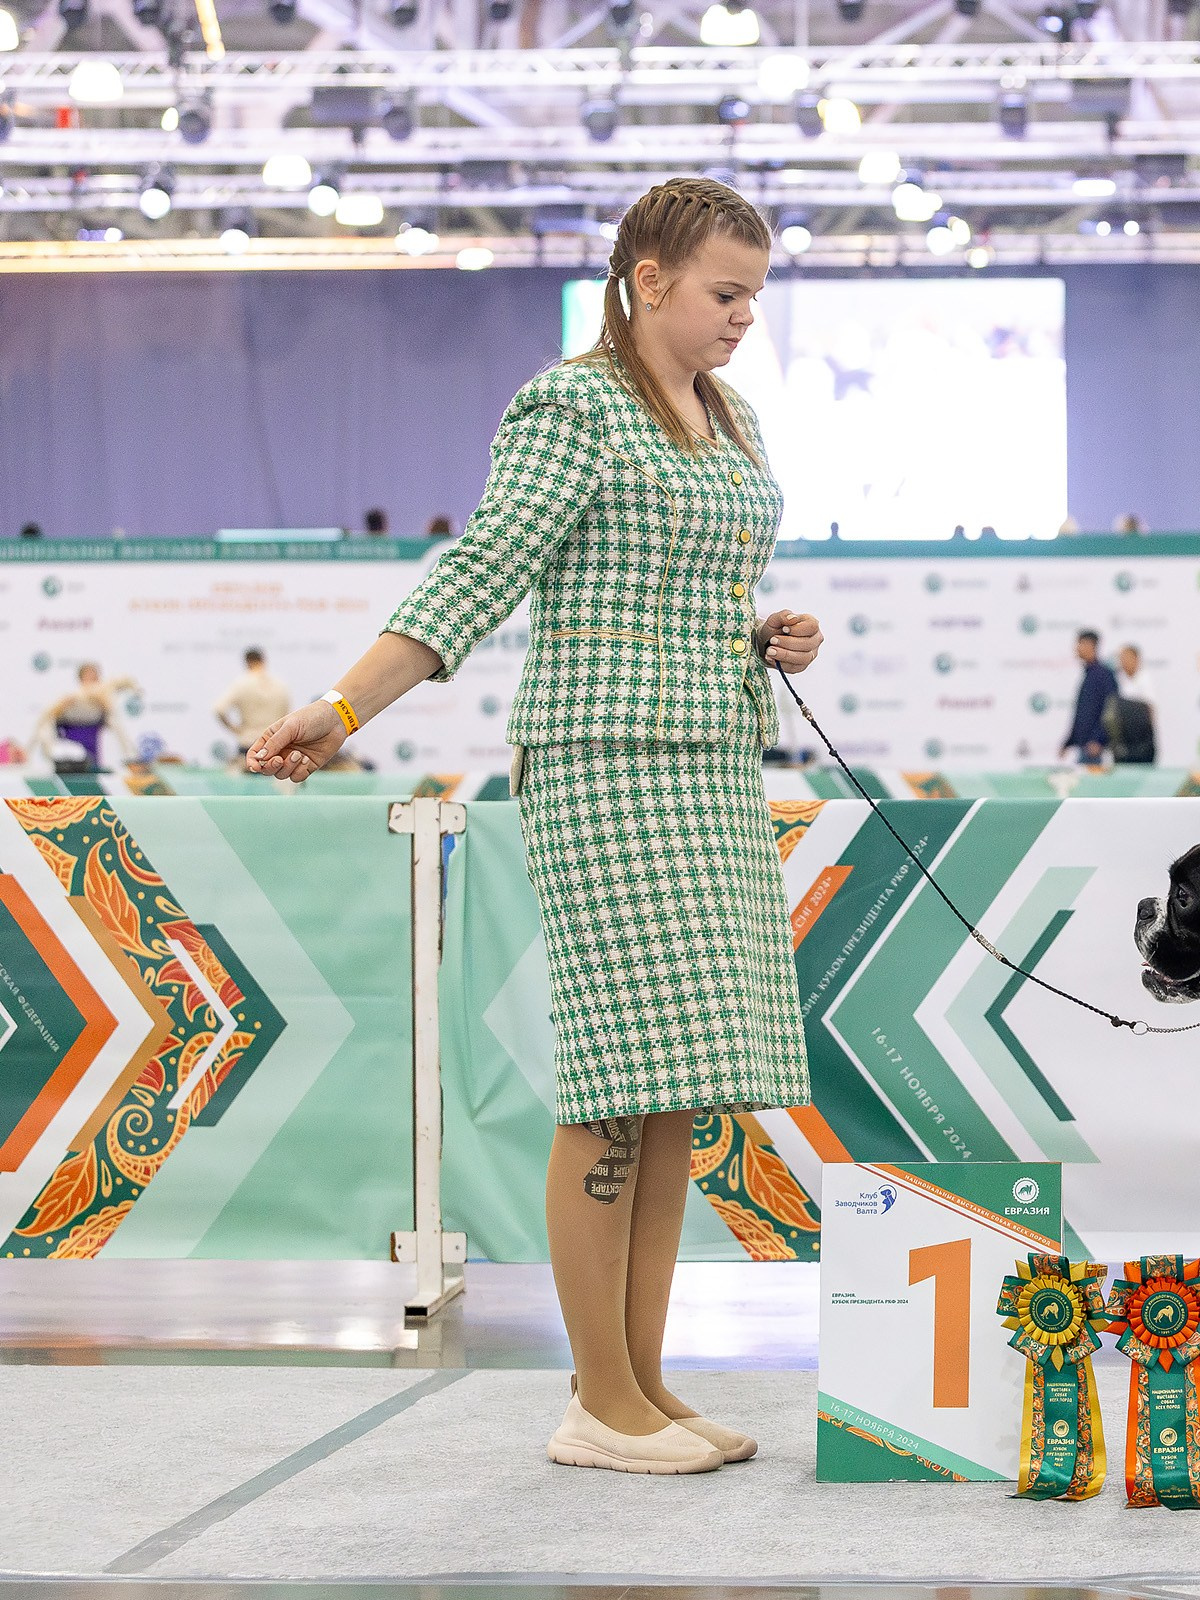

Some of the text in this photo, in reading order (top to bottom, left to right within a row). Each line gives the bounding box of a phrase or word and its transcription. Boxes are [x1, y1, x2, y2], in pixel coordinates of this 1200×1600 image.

[818, 955, 846, 992] КУБОК
[843, 887, 895, 956] ПРЕЗИДЕНТА
[890, 864, 910, 887] РКФ
[17, 995, 60, 1053] ФЕДЕРАЦИЯ
[900, 1066, 946, 1125] НОЯБРЯ
[942, 1126, 973, 1159] 2024
[591, 1183, 623, 1194] CKTAPE
[834, 1200, 878, 1208] Заводчиков
[859, 1192, 878, 1200] Клуб
[904, 1174, 1051, 1247] НАЦИОНАЛЬНЫЕ ВЫСТАВКИ СОБАК ВСЕХ ПОРОД
[1004, 1207, 1050, 1216] ЕВРАЗИЯ
[908, 1238, 971, 1408] 1
[829, 1402, 919, 1450] 16-17 НОЯБРЯ 2024
[1153, 1446, 1185, 1454] ЕВРАЗИЯ
